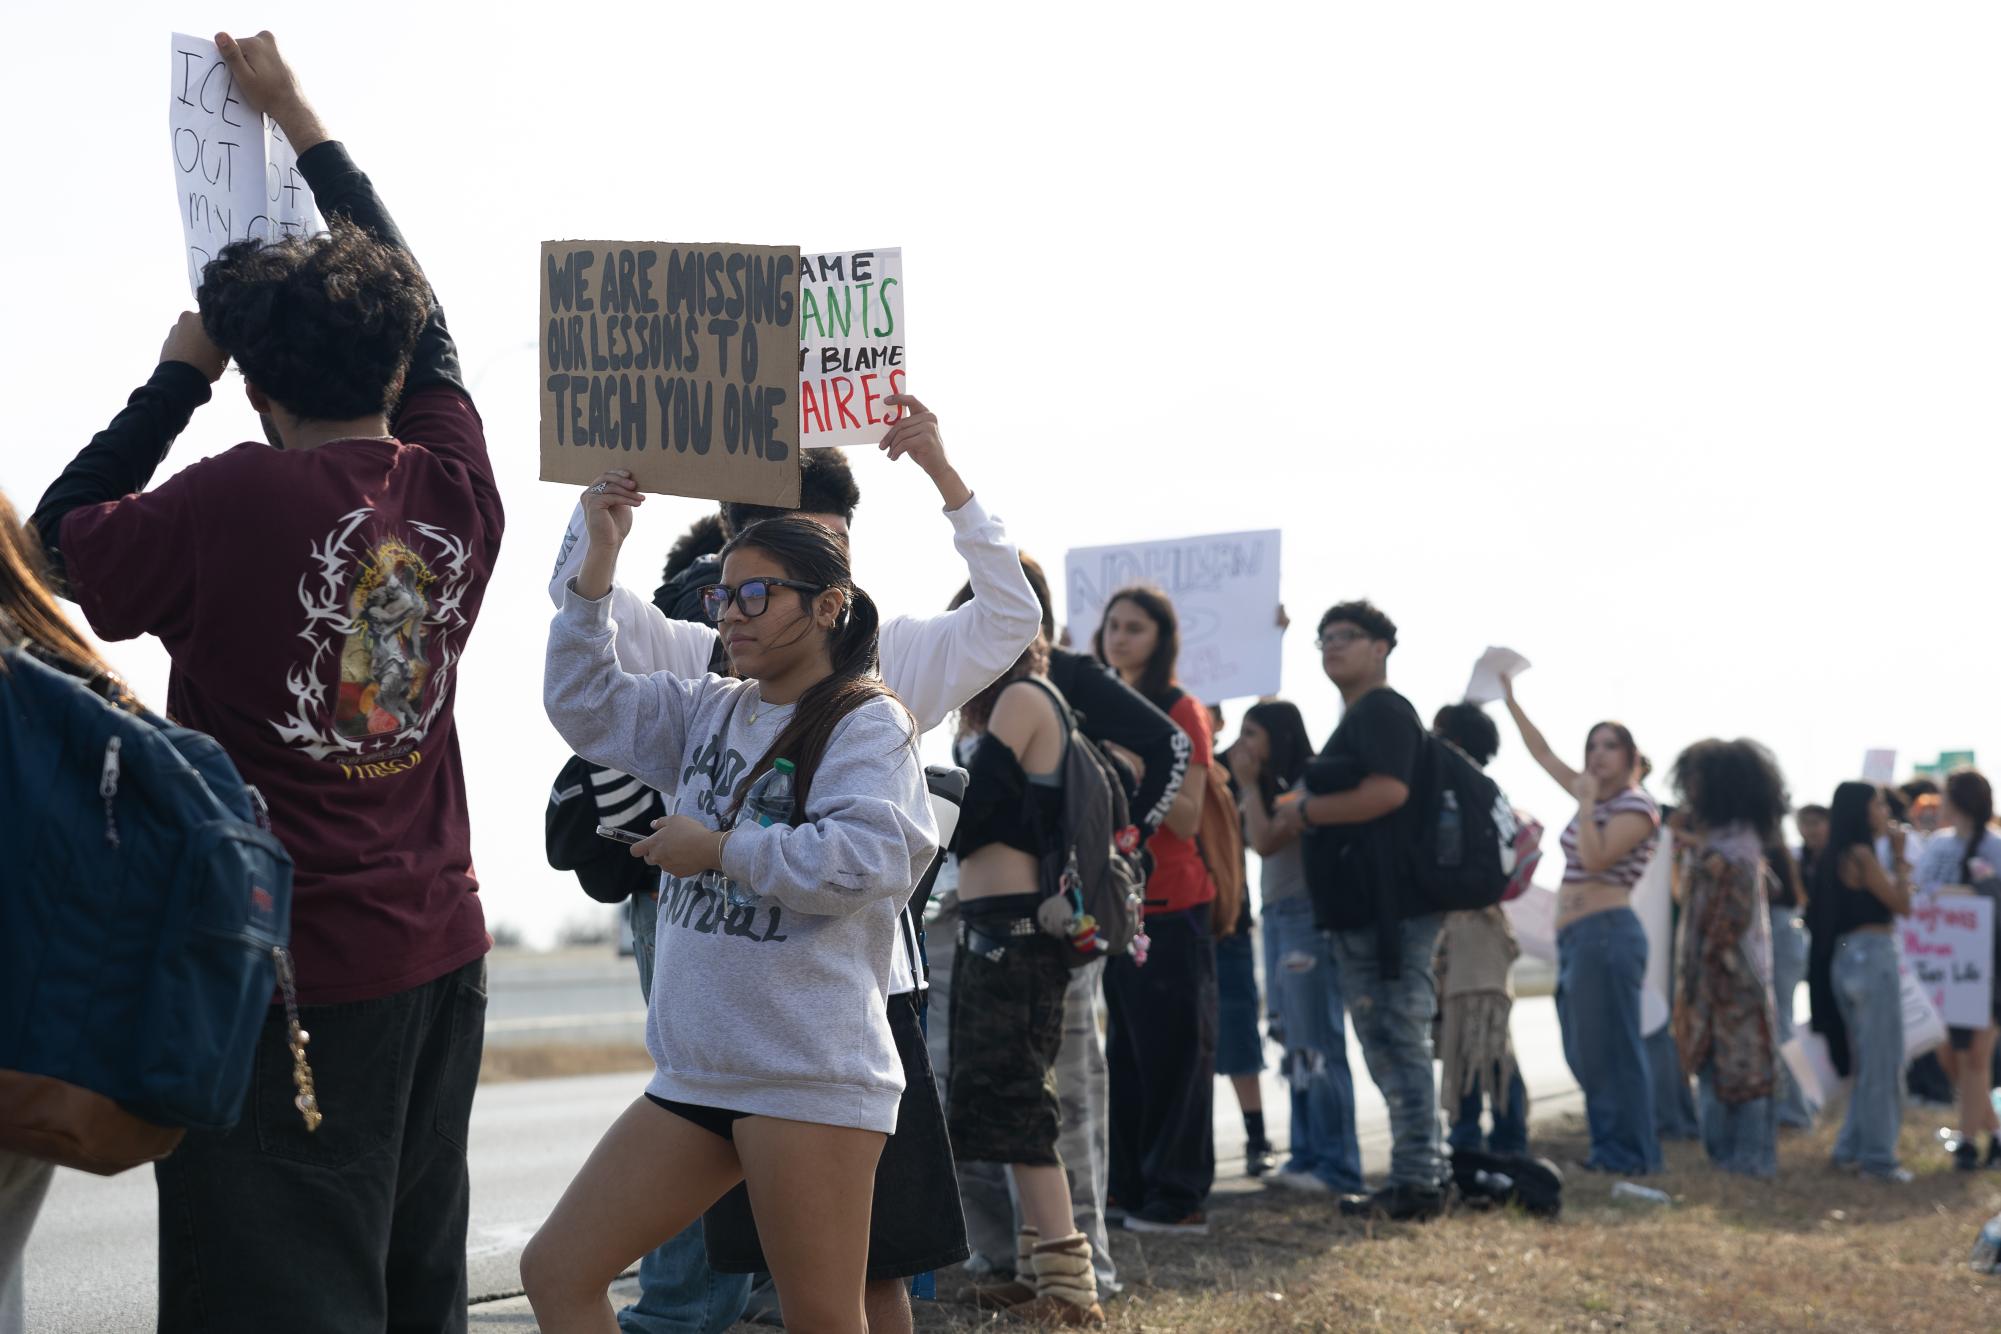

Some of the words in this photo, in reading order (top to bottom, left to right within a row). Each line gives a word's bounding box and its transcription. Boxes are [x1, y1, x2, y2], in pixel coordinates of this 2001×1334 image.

[177, 50, 241, 127] ICE
[174, 127, 241, 193] OUT
[188, 191, 231, 246] MY
[548, 250, 595, 314] WE
[600, 250, 660, 314] ARE
[666, 249, 794, 327] MISSING
[800, 277, 898, 340] ANTS
[549, 315, 588, 372] OUR
[590, 312, 700, 373] LESSONS
[707, 318, 759, 384] TO
[821, 345, 904, 374] BLAME
[546, 373, 647, 451] TEACH
[654, 374, 713, 456] YOU
[722, 382, 789, 462] ONE
[802, 368, 905, 434] AIRES
[1143, 731, 1190, 827] SHAME
